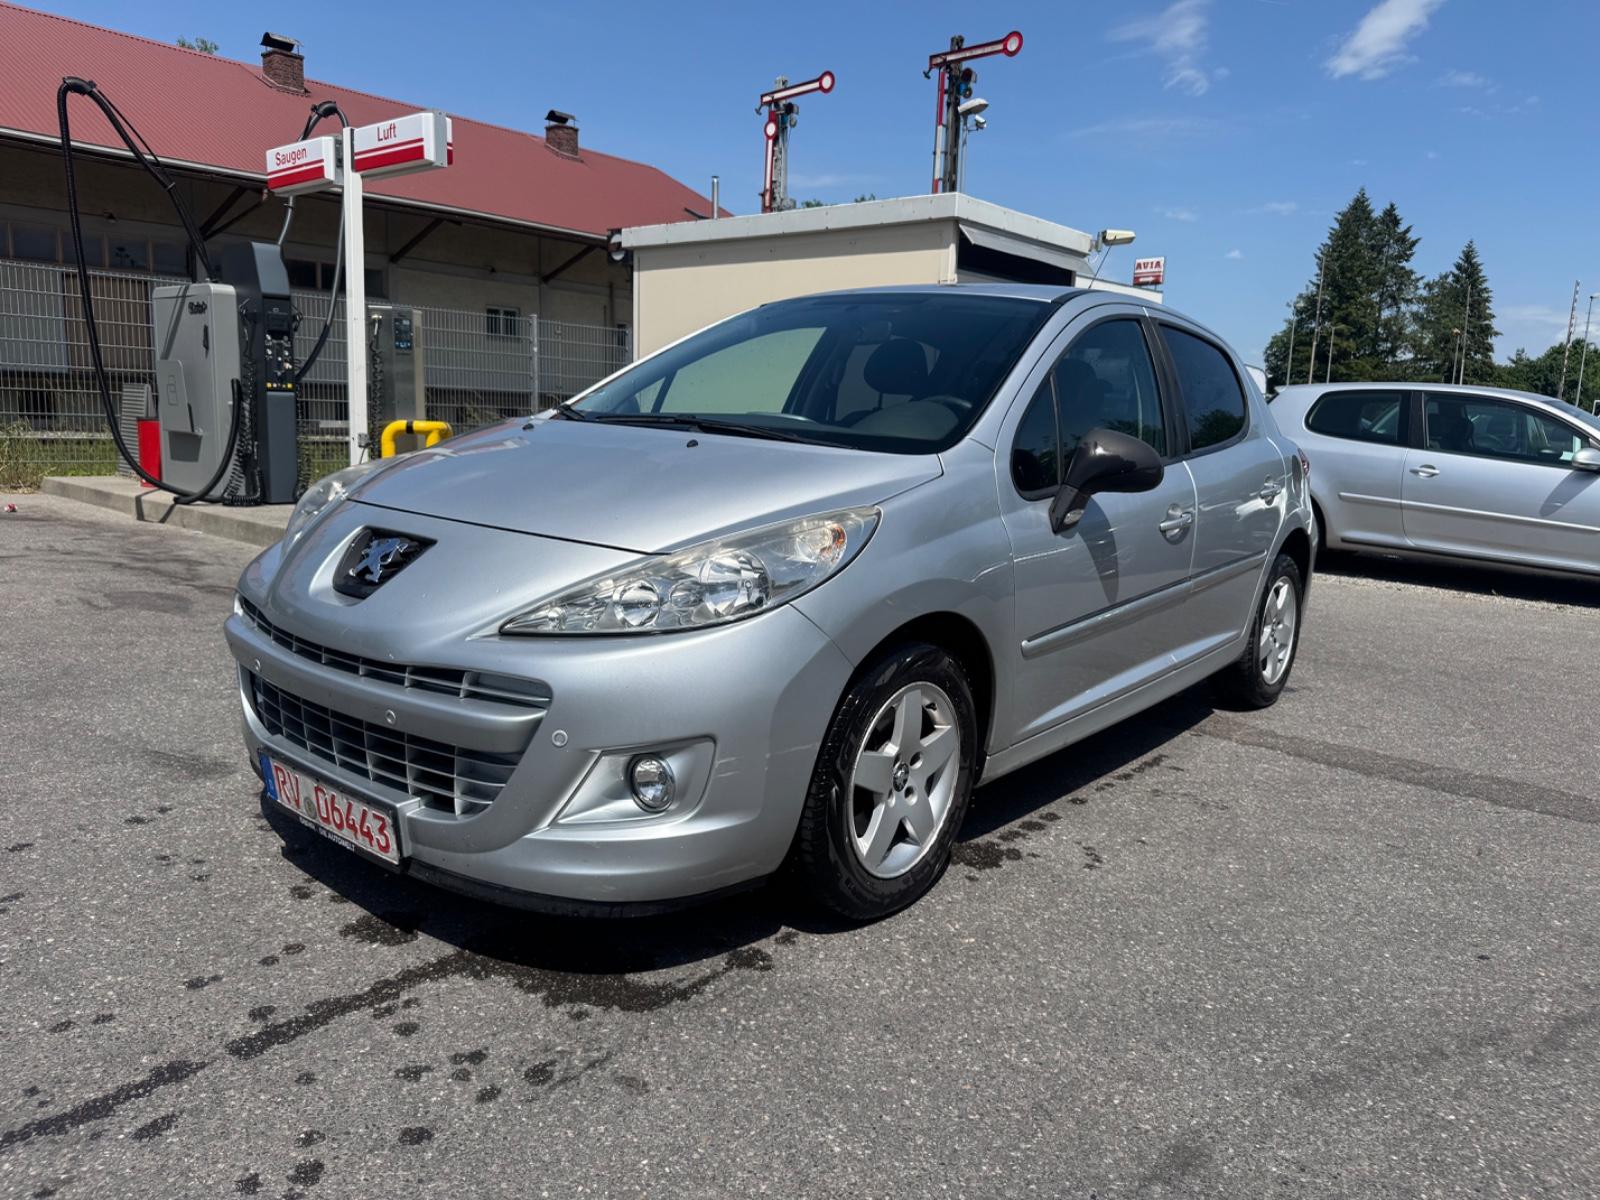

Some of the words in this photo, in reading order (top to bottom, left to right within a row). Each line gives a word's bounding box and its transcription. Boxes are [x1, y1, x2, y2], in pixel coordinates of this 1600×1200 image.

[377, 124, 397, 142] Luft
[275, 147, 307, 166] Saugen
[1135, 261, 1161, 270] AVIA
[273, 763, 300, 810] RV
[314, 784, 391, 854] 06443
